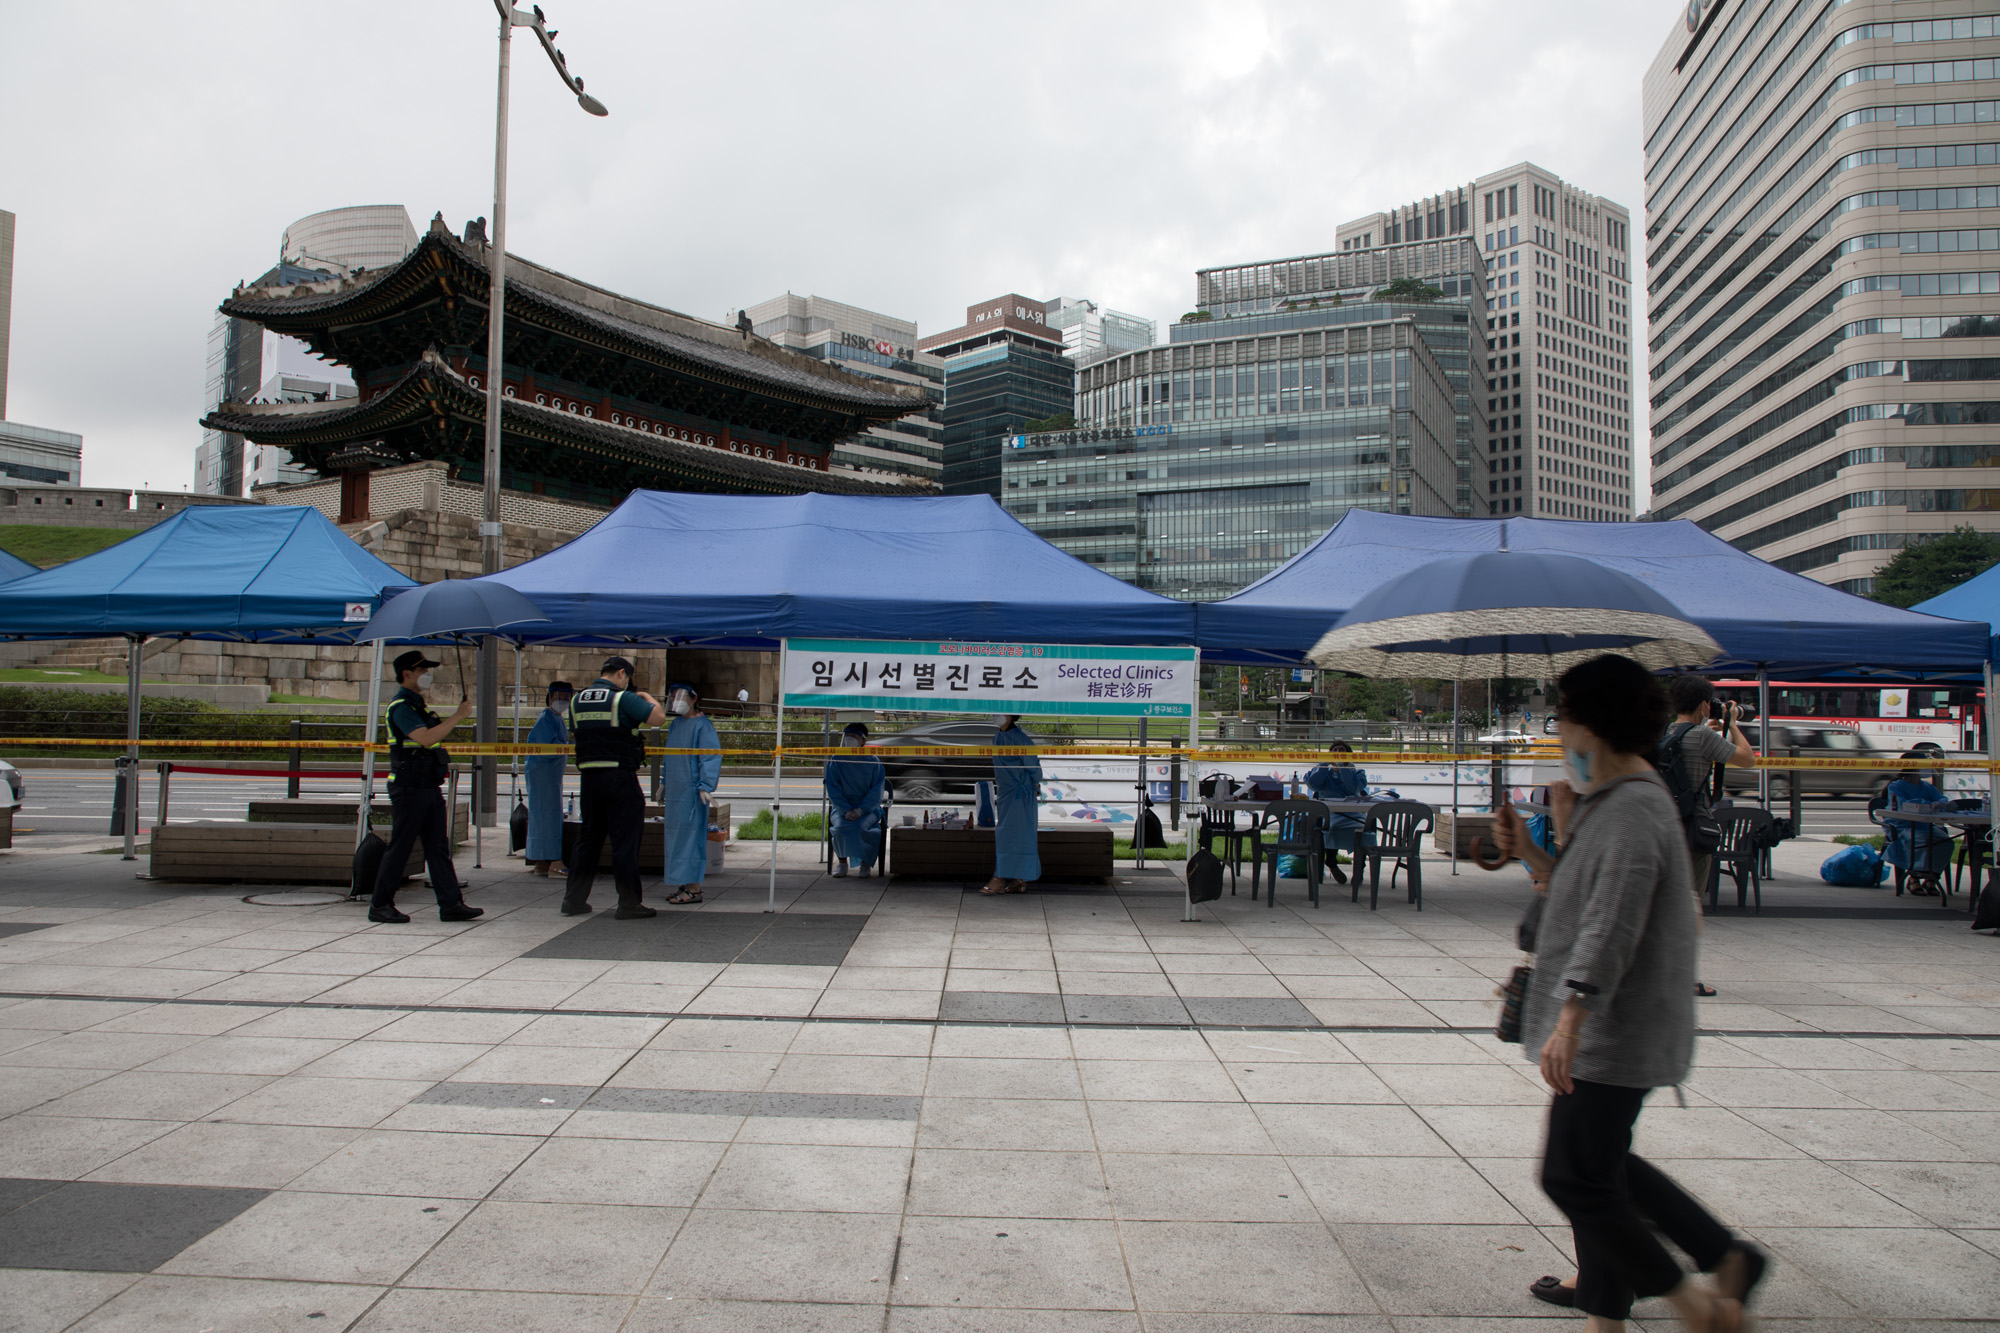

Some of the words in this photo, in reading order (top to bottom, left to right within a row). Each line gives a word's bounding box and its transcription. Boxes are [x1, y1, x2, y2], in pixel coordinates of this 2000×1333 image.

[841, 332, 875, 352] HSBC
[1136, 424, 1172, 437] KCCI
[811, 660, 1039, 691] 임시선별진료소
[1057, 663, 1122, 680] Selected
[1126, 665, 1174, 680] Clinics
[583, 690, 605, 701] 경찰
[1087, 682, 1153, 699] 指定诊所
[1154, 705, 1184, 714] 중구보건소
